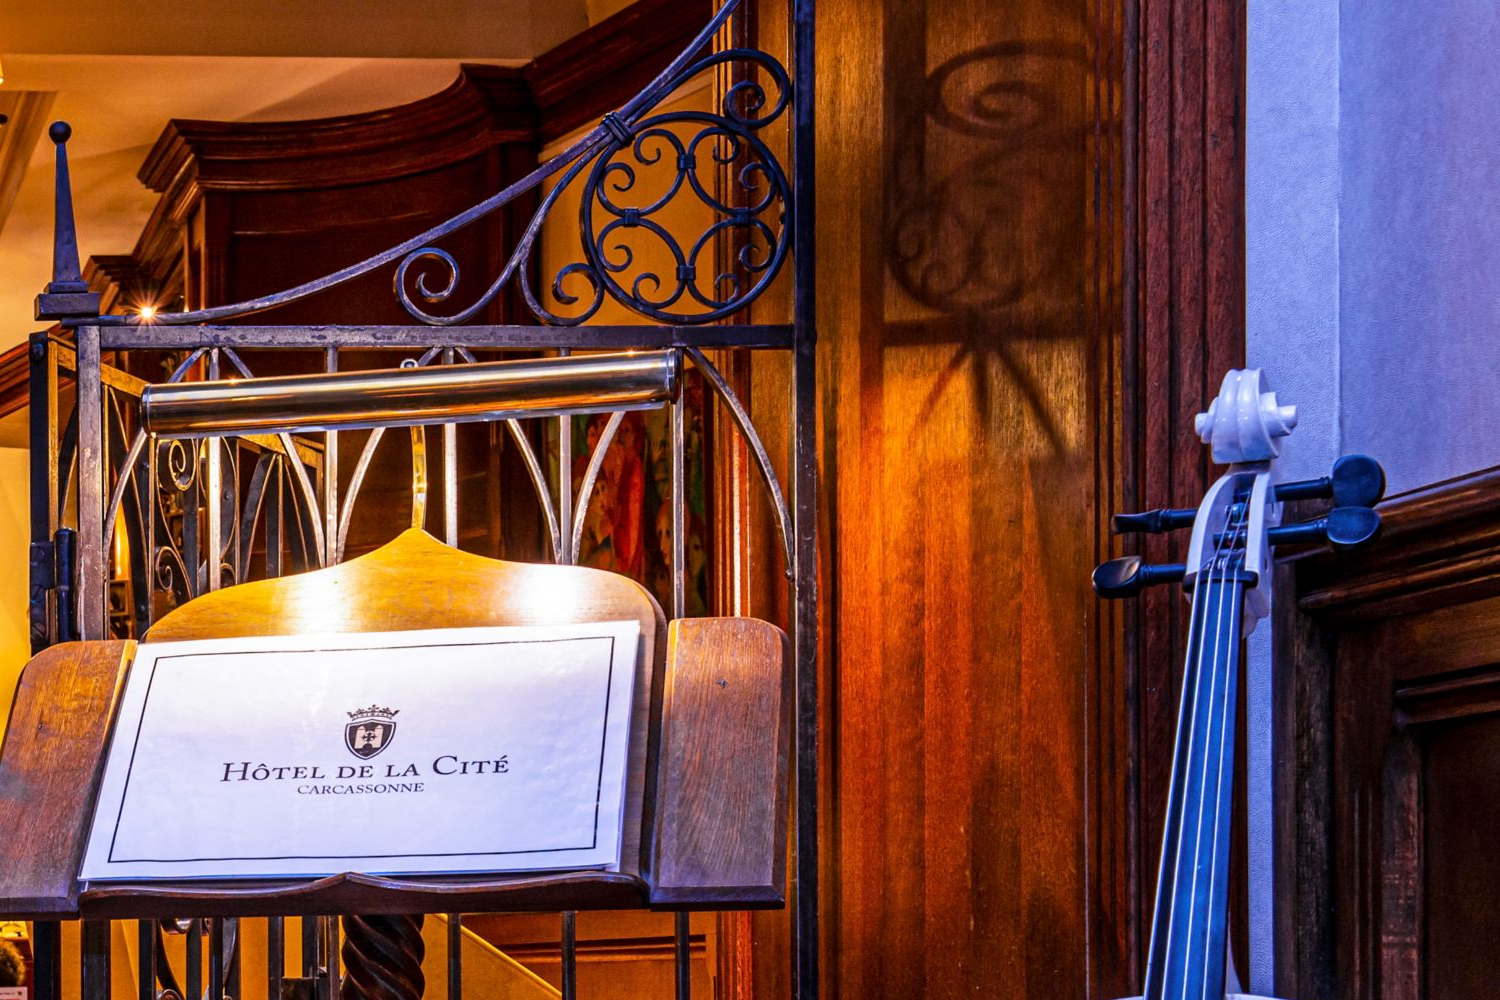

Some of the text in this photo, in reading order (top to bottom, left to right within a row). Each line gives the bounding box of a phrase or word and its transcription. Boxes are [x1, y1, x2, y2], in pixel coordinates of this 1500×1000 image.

[336, 765, 373, 779] DE
[385, 763, 420, 778] LA
[297, 782, 424, 795] CARCASSONNE
